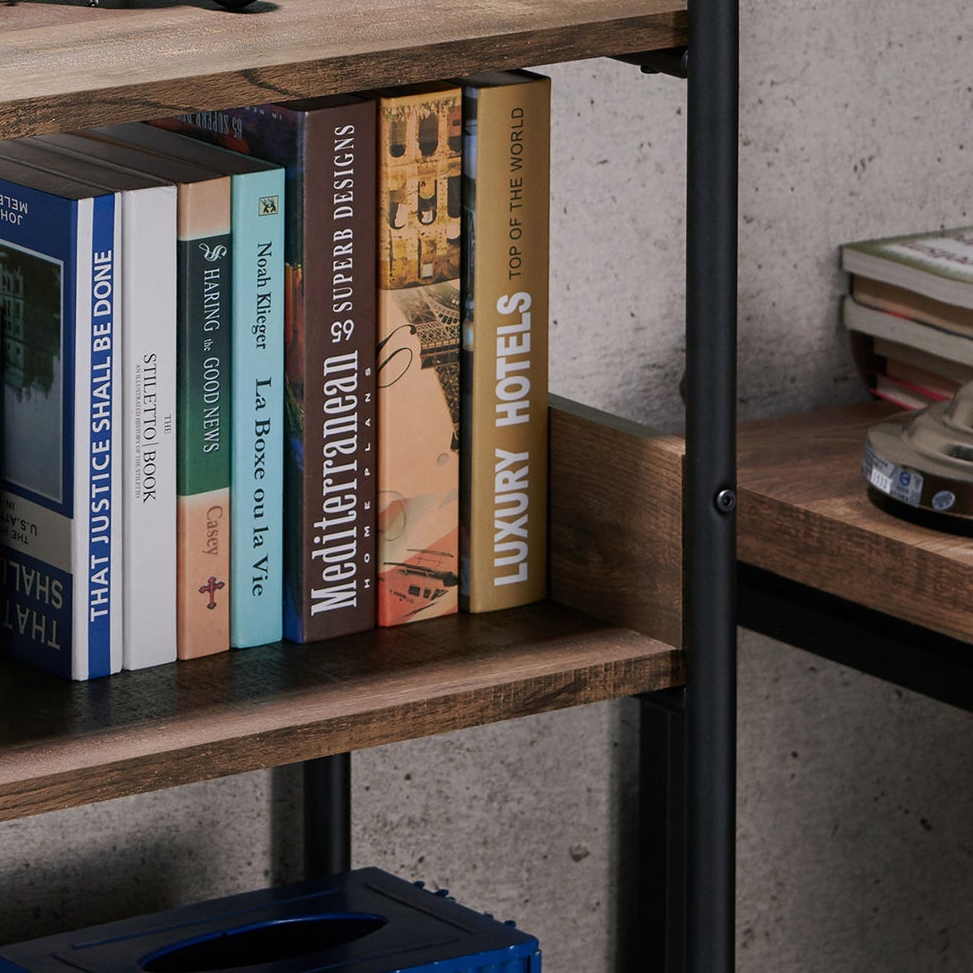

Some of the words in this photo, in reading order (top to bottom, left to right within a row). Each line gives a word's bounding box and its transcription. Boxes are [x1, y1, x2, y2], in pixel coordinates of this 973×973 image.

[510, 107, 524, 172] WORLD
[333, 124, 355, 219] DESIGNS
[510, 177, 523, 212] THE
[509, 218, 523, 240] OF
[93, 250, 112, 317] DONE
[256, 241, 272, 288] Noah
[332, 228, 353, 313] SUPERB
[508, 246, 522, 280] TOP
[93, 322, 111, 352] BE
[203, 338, 214, 351] the
[251, 292, 272, 350] Klieger
[331, 319, 355, 343] 65
[203, 357, 220, 404] GOOD
[495, 291, 532, 427] HOTELS
[92, 356, 111, 433] SHALL
[143, 353, 157, 441] STILETTO
[255, 376, 272, 411] La
[164, 413, 172, 435] THE
[203, 405, 220, 454] NEWS
[254, 417, 270, 480] Boxe
[91, 439, 110, 544] JUSTICE
[142, 450, 157, 504] BOOK
[310, 350, 358, 616] Mediterranean
[253, 488, 265, 519] ou
[494, 448, 529, 587] LUXURY
[202, 505, 224, 556] Casey
[252, 526, 269, 549] la
[90, 554, 109, 622] THAT
[251, 553, 269, 597] Vie
[1, 600, 61, 651] THAT
